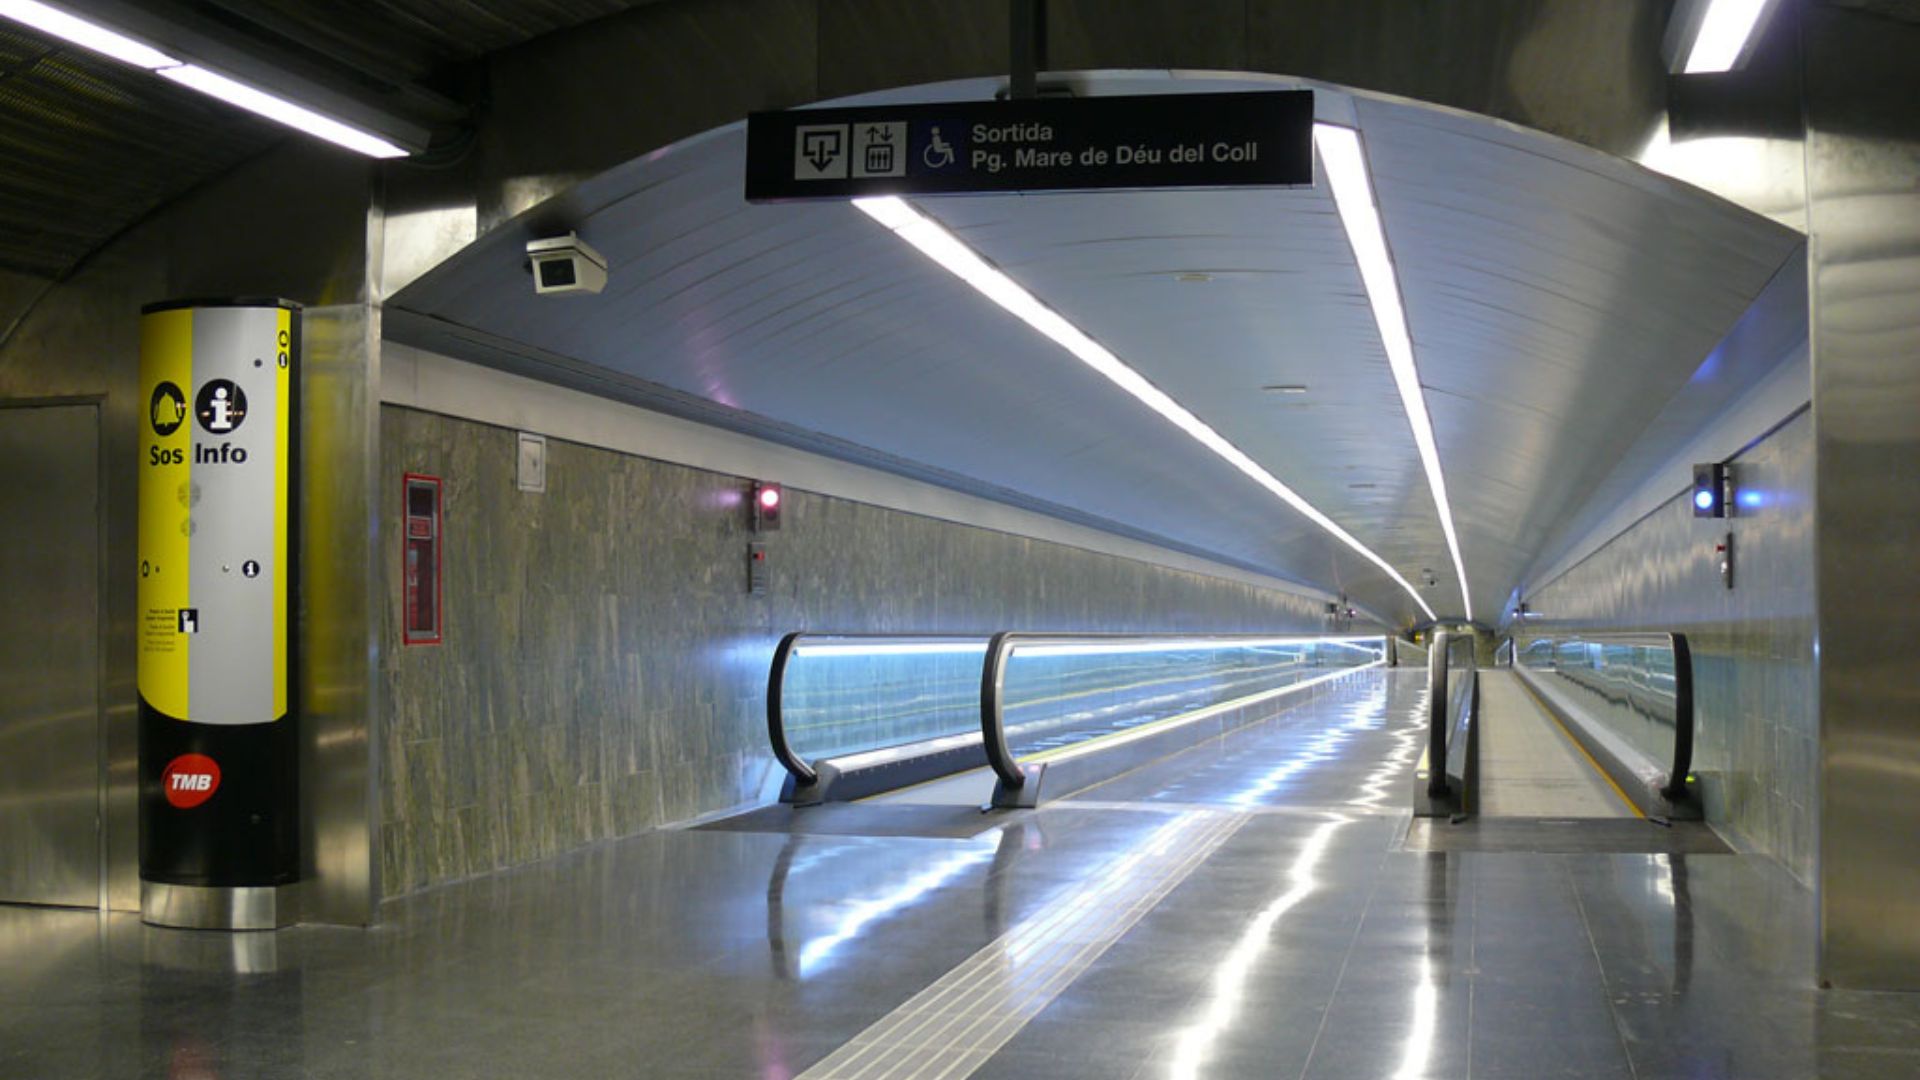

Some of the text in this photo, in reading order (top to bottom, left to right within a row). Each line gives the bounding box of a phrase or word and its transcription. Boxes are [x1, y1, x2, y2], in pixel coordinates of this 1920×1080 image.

[972, 123, 1053, 143] Sortida
[971, 142, 1258, 172] Pg. Mare de Déu del Coll
[149, 442, 247, 466] Sos Info
[172, 774, 212, 790] TMB
